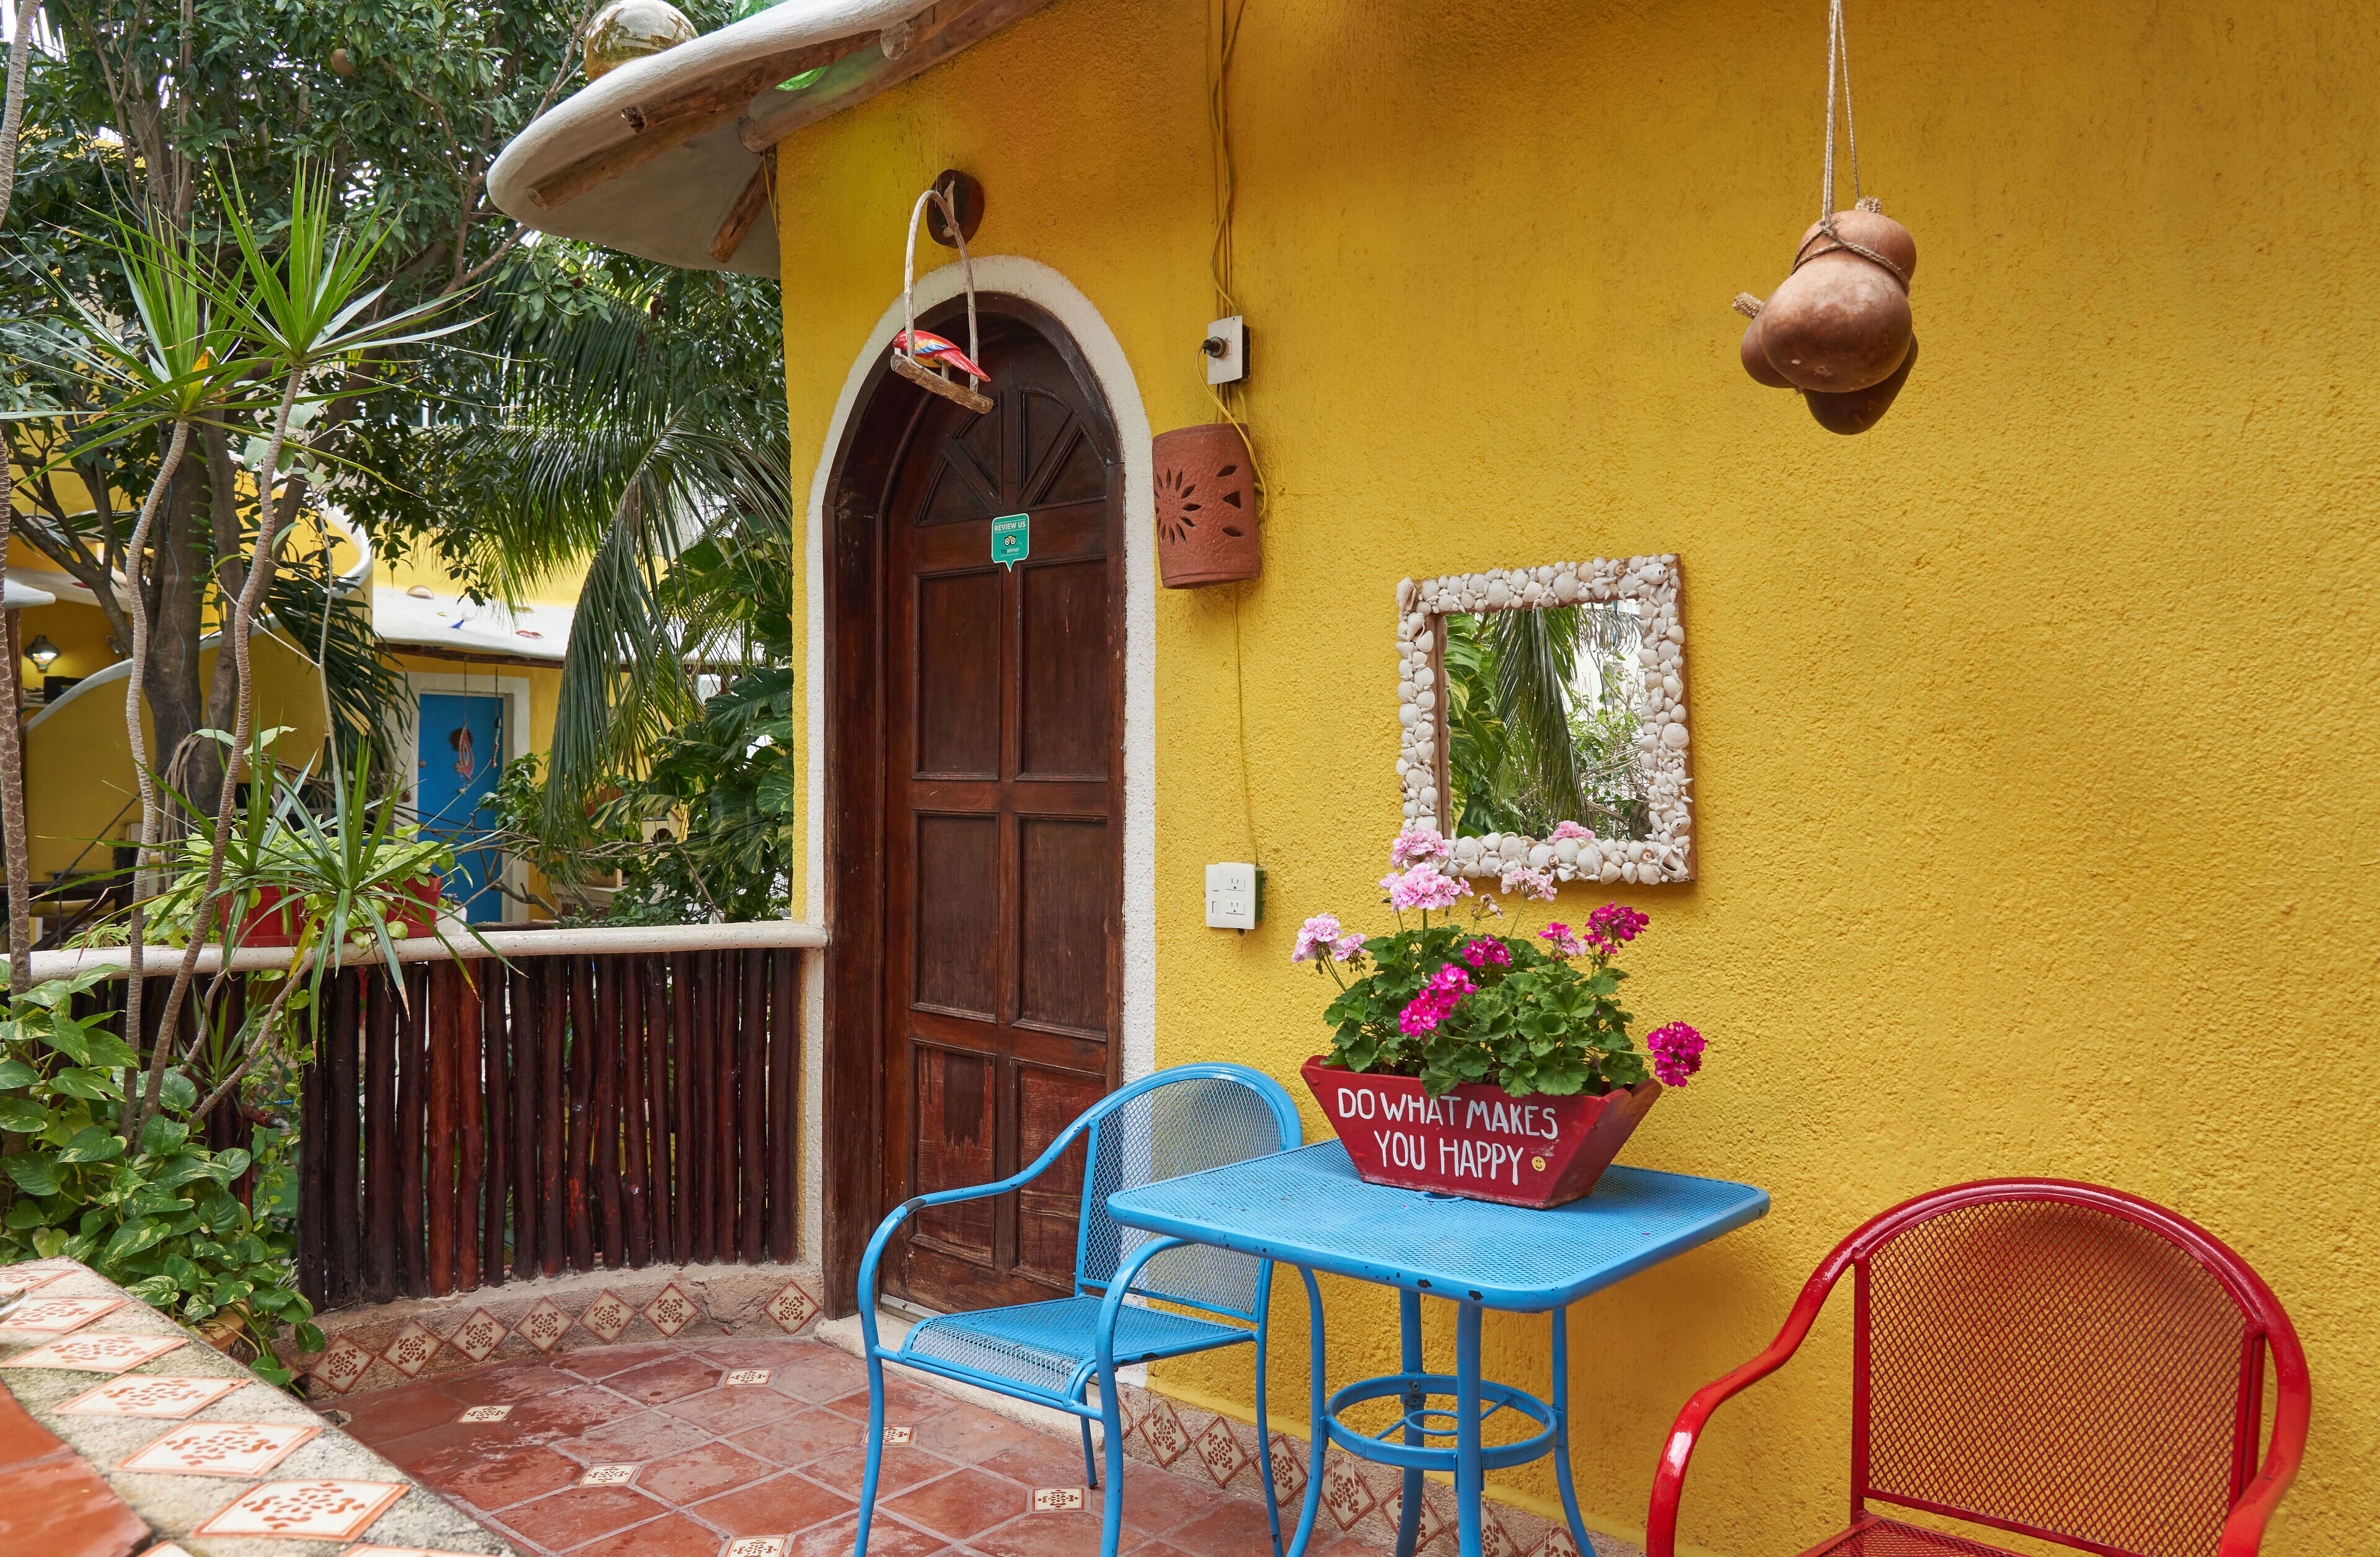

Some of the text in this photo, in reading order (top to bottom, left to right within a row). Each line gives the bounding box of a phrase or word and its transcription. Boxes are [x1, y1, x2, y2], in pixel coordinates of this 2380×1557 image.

[994, 522, 1016, 532] REVIEW
[1338, 1088, 1558, 1139] DO WHAT MAKES
[1373, 1130, 1524, 1185] YOU HAPPY
